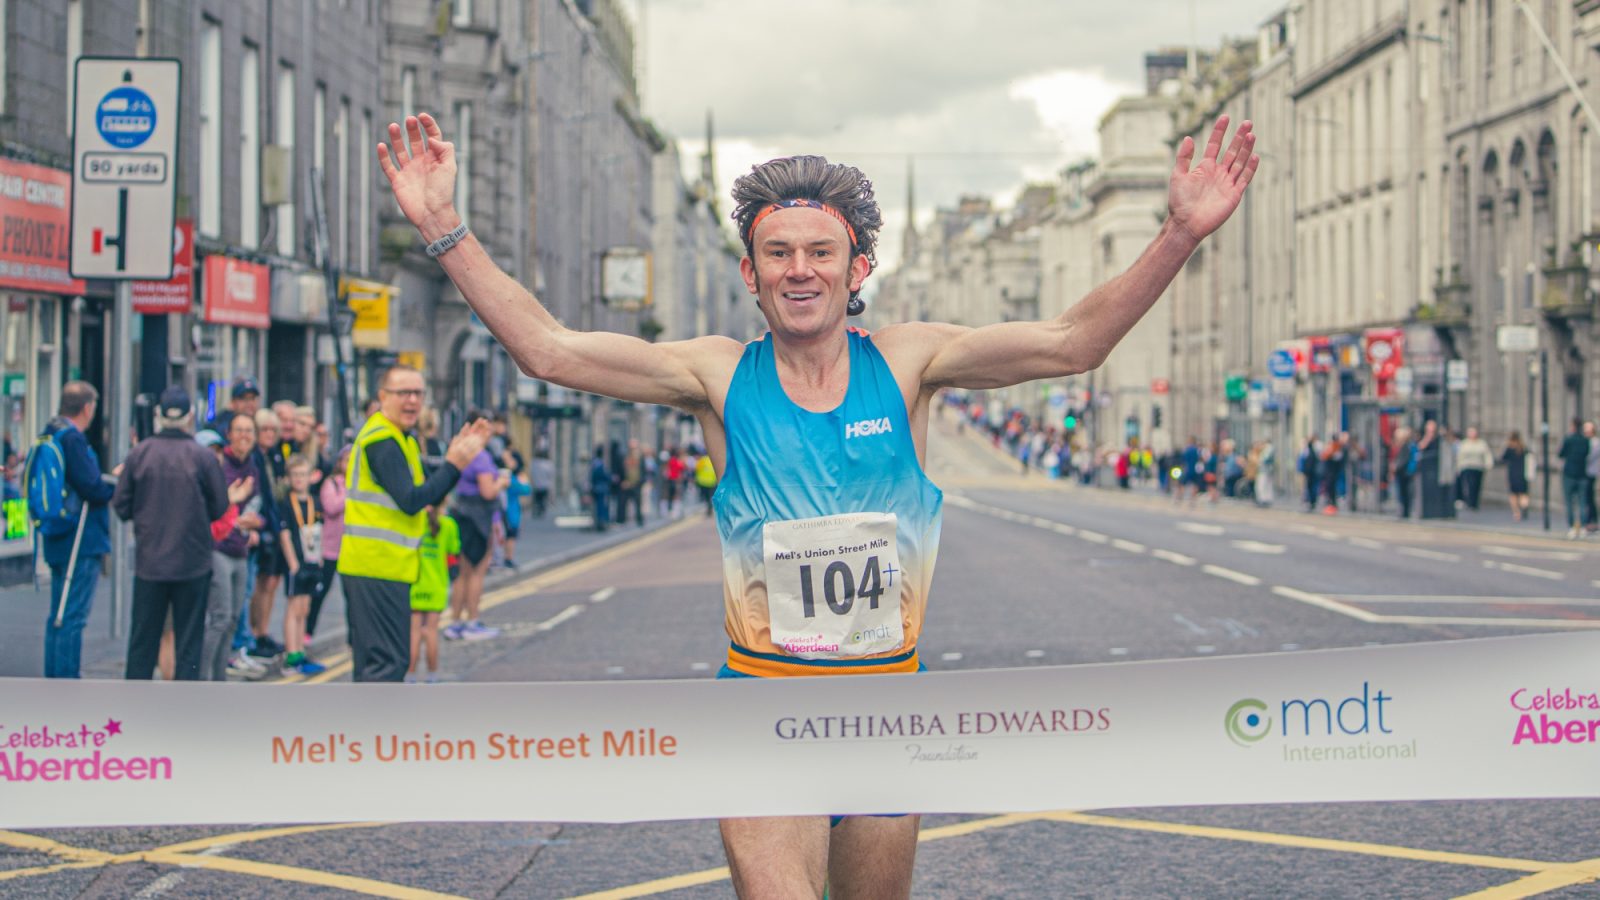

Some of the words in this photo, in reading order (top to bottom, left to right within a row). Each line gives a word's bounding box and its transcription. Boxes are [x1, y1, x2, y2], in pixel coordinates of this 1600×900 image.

[90, 160, 112, 174] 90
[117, 161, 159, 175] yards
[3, 215, 56, 259] PHONE
[845, 416, 893, 440] HOKA
[775, 551, 802, 561] Mel's
[804, 548, 835, 559] Union
[838, 543, 867, 555] Street
[869, 538, 889, 549] Mile
[799, 555, 885, 618] 104
[863, 624, 891, 641] mdt
[784, 643, 840, 654] Aberdeen
[1282, 681, 1392, 737] mdt
[775, 713, 946, 740] GATHIMBA
[957, 707, 1112, 735] EDWARDS
[271, 734, 363, 764] Mel's
[375, 733, 477, 763] Union
[487, 731, 591, 760] Street
[602, 728, 678, 757] Mile
[904, 743, 979, 764] Foundation
[1283, 740, 1417, 763] International
